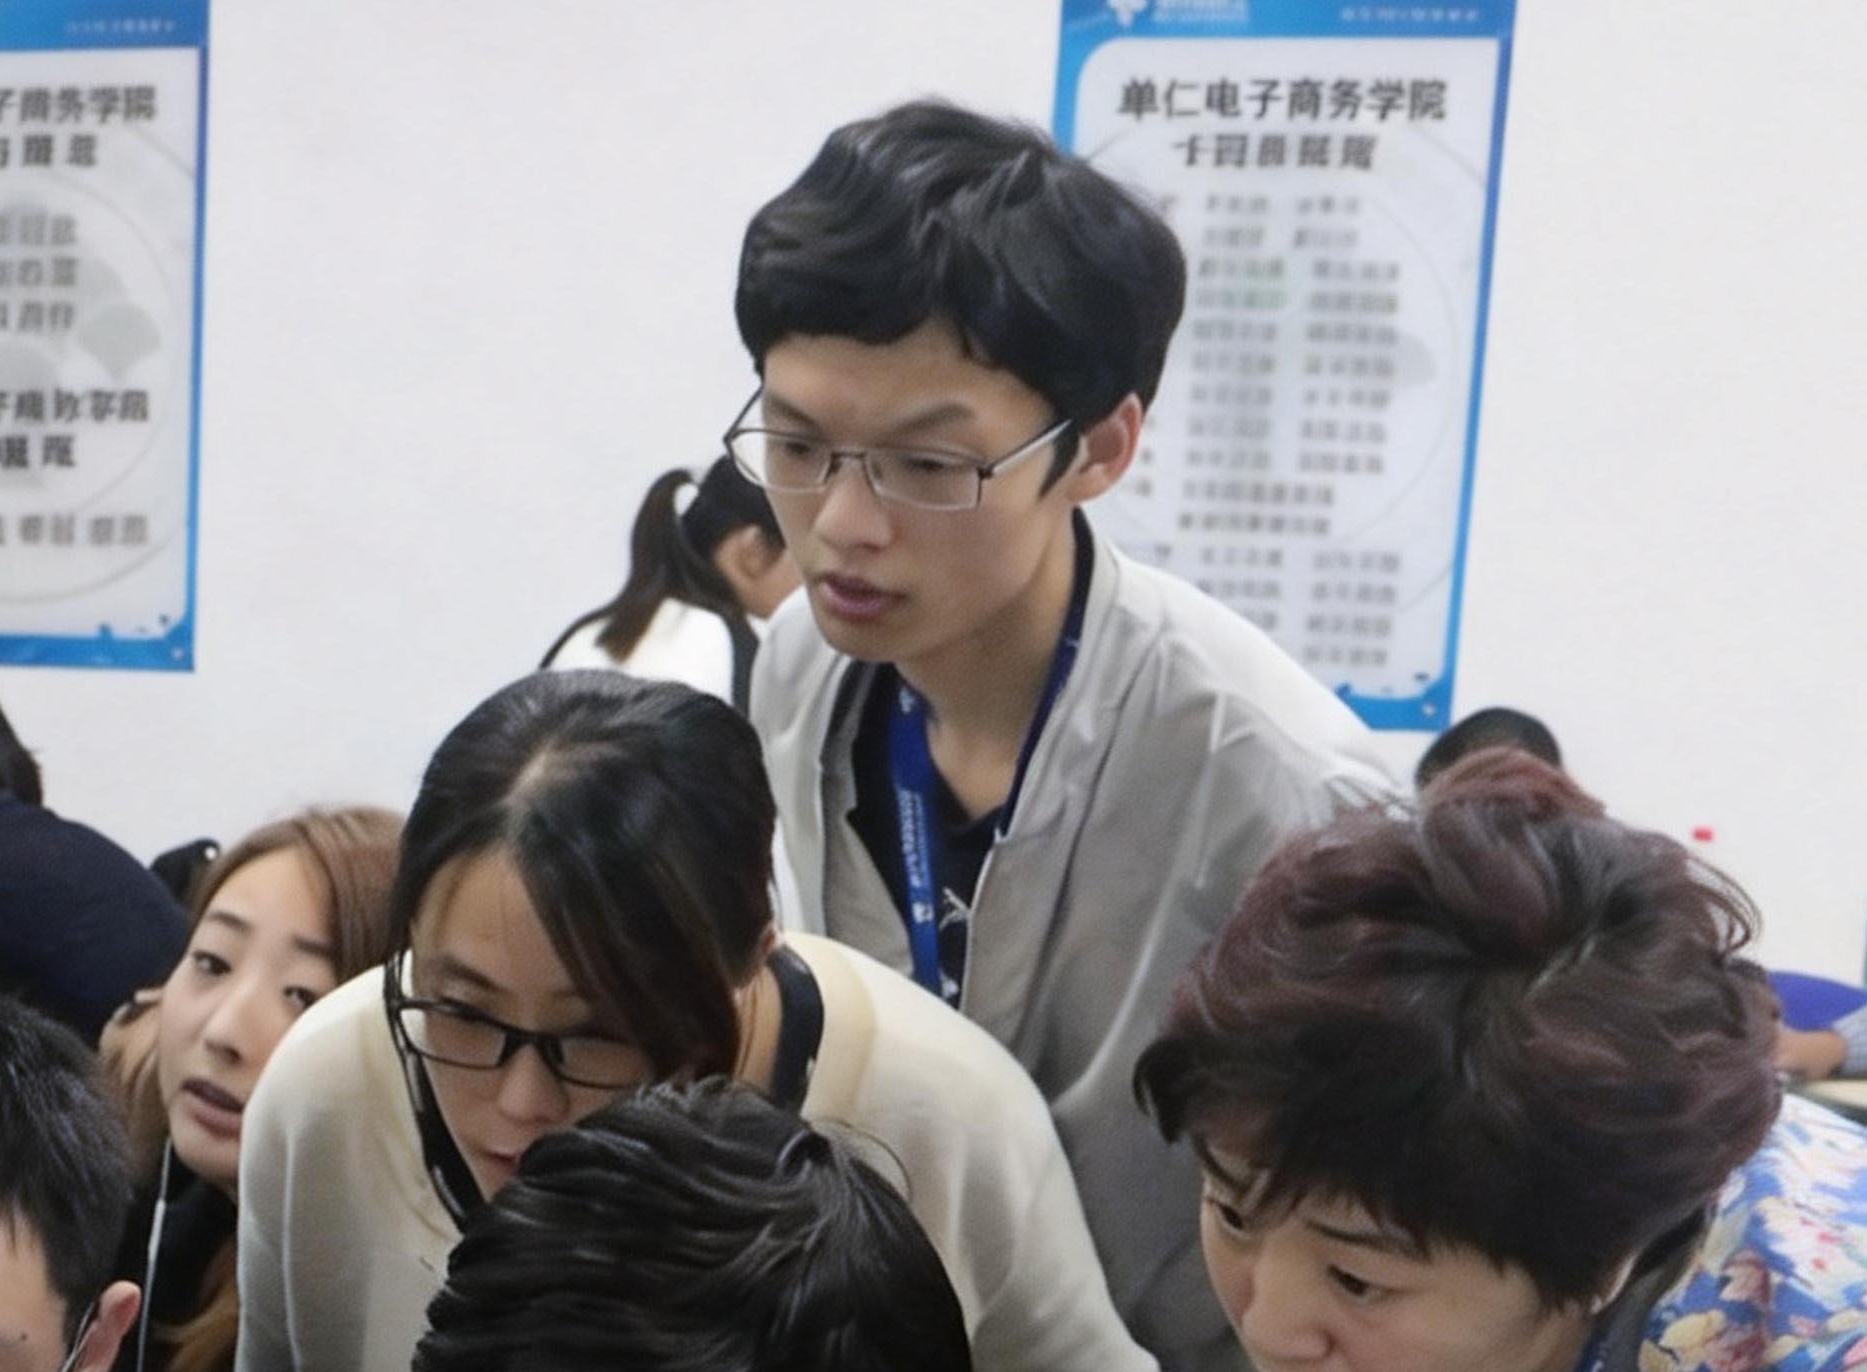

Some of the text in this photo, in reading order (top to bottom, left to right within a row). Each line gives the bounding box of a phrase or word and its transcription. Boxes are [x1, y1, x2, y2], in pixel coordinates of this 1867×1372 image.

[1118, 78, 1447, 121] 单仁电子商务学院
